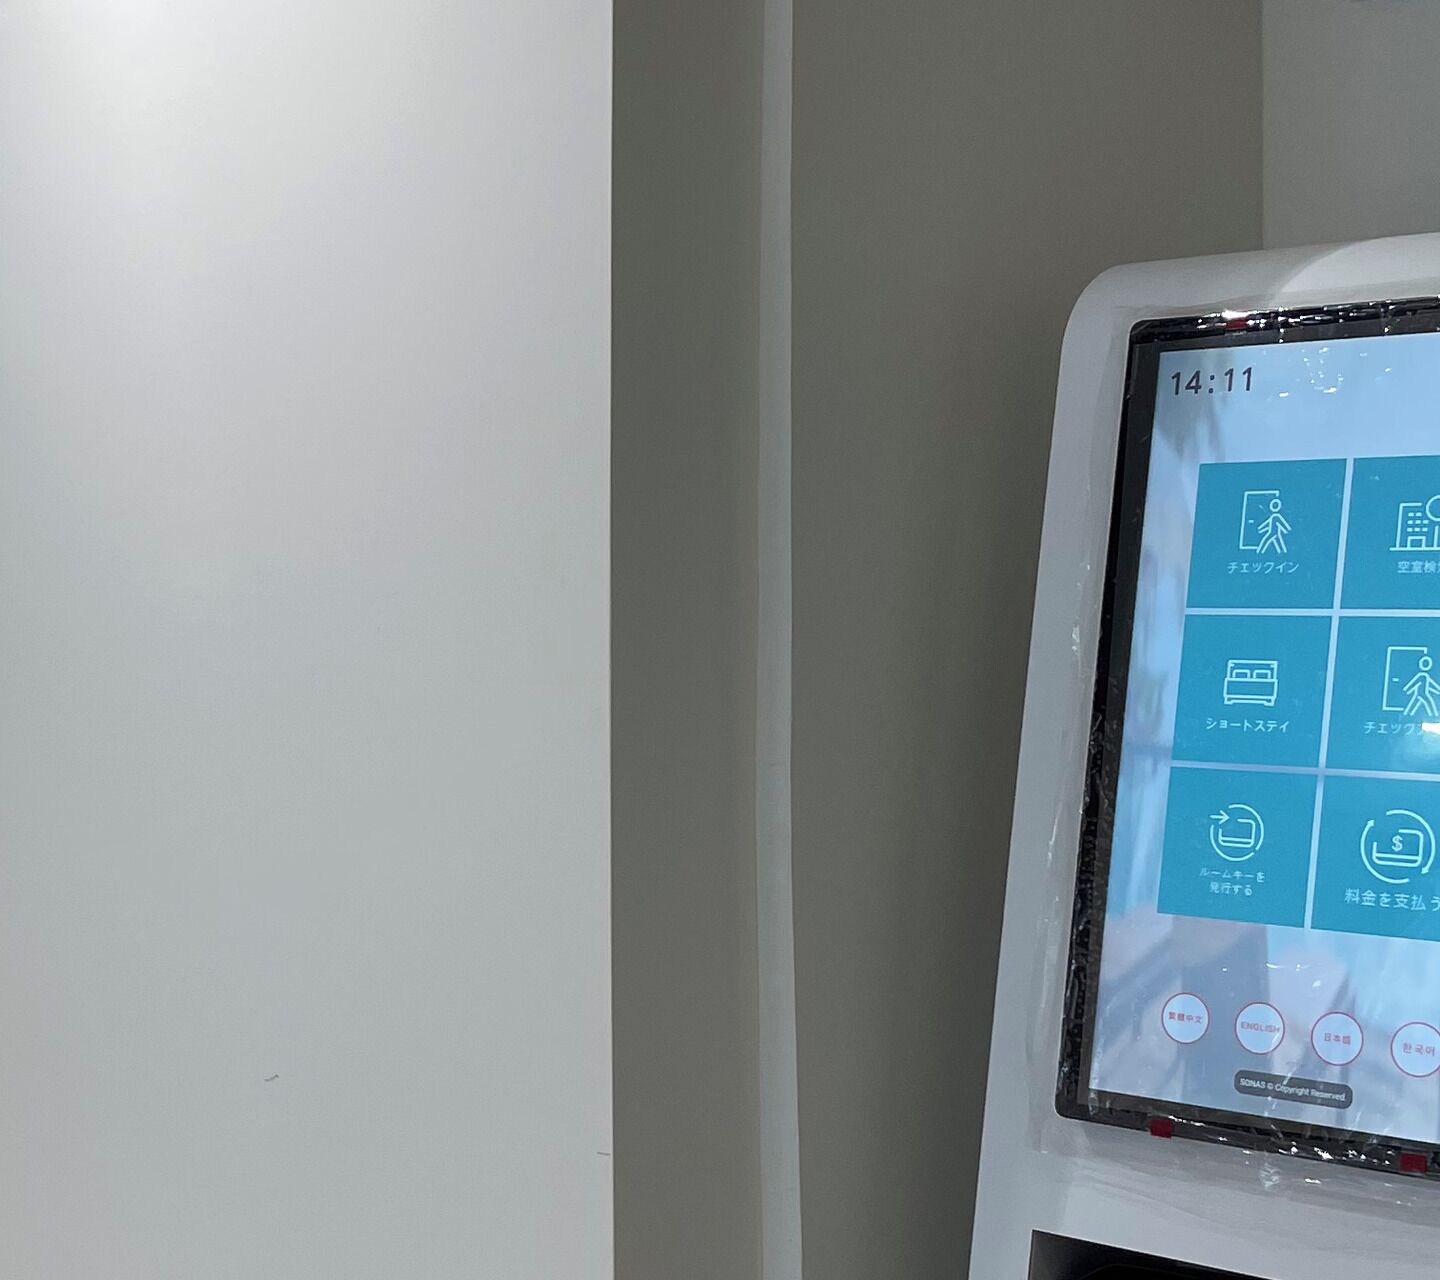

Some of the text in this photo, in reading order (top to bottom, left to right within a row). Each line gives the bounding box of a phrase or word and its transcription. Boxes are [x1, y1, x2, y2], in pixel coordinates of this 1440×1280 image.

[1171, 366, 1252, 396] 14:11
[1227, 560, 1300, 575] チェックイン
[1397, 560, 1440, 574] 空室検
[1205, 717, 1290, 733] ショートステイ
[1199, 867, 1265, 883] ルームキーを
[1209, 881, 1253, 897] 発行する
[1240, 1021, 1280, 1034] ENGLISH
[1402, 1042, 1436, 1057] 한국어
[1275, 1083, 1310, 1097] Copyright
[1311, 1088, 1346, 1102] Reserved
